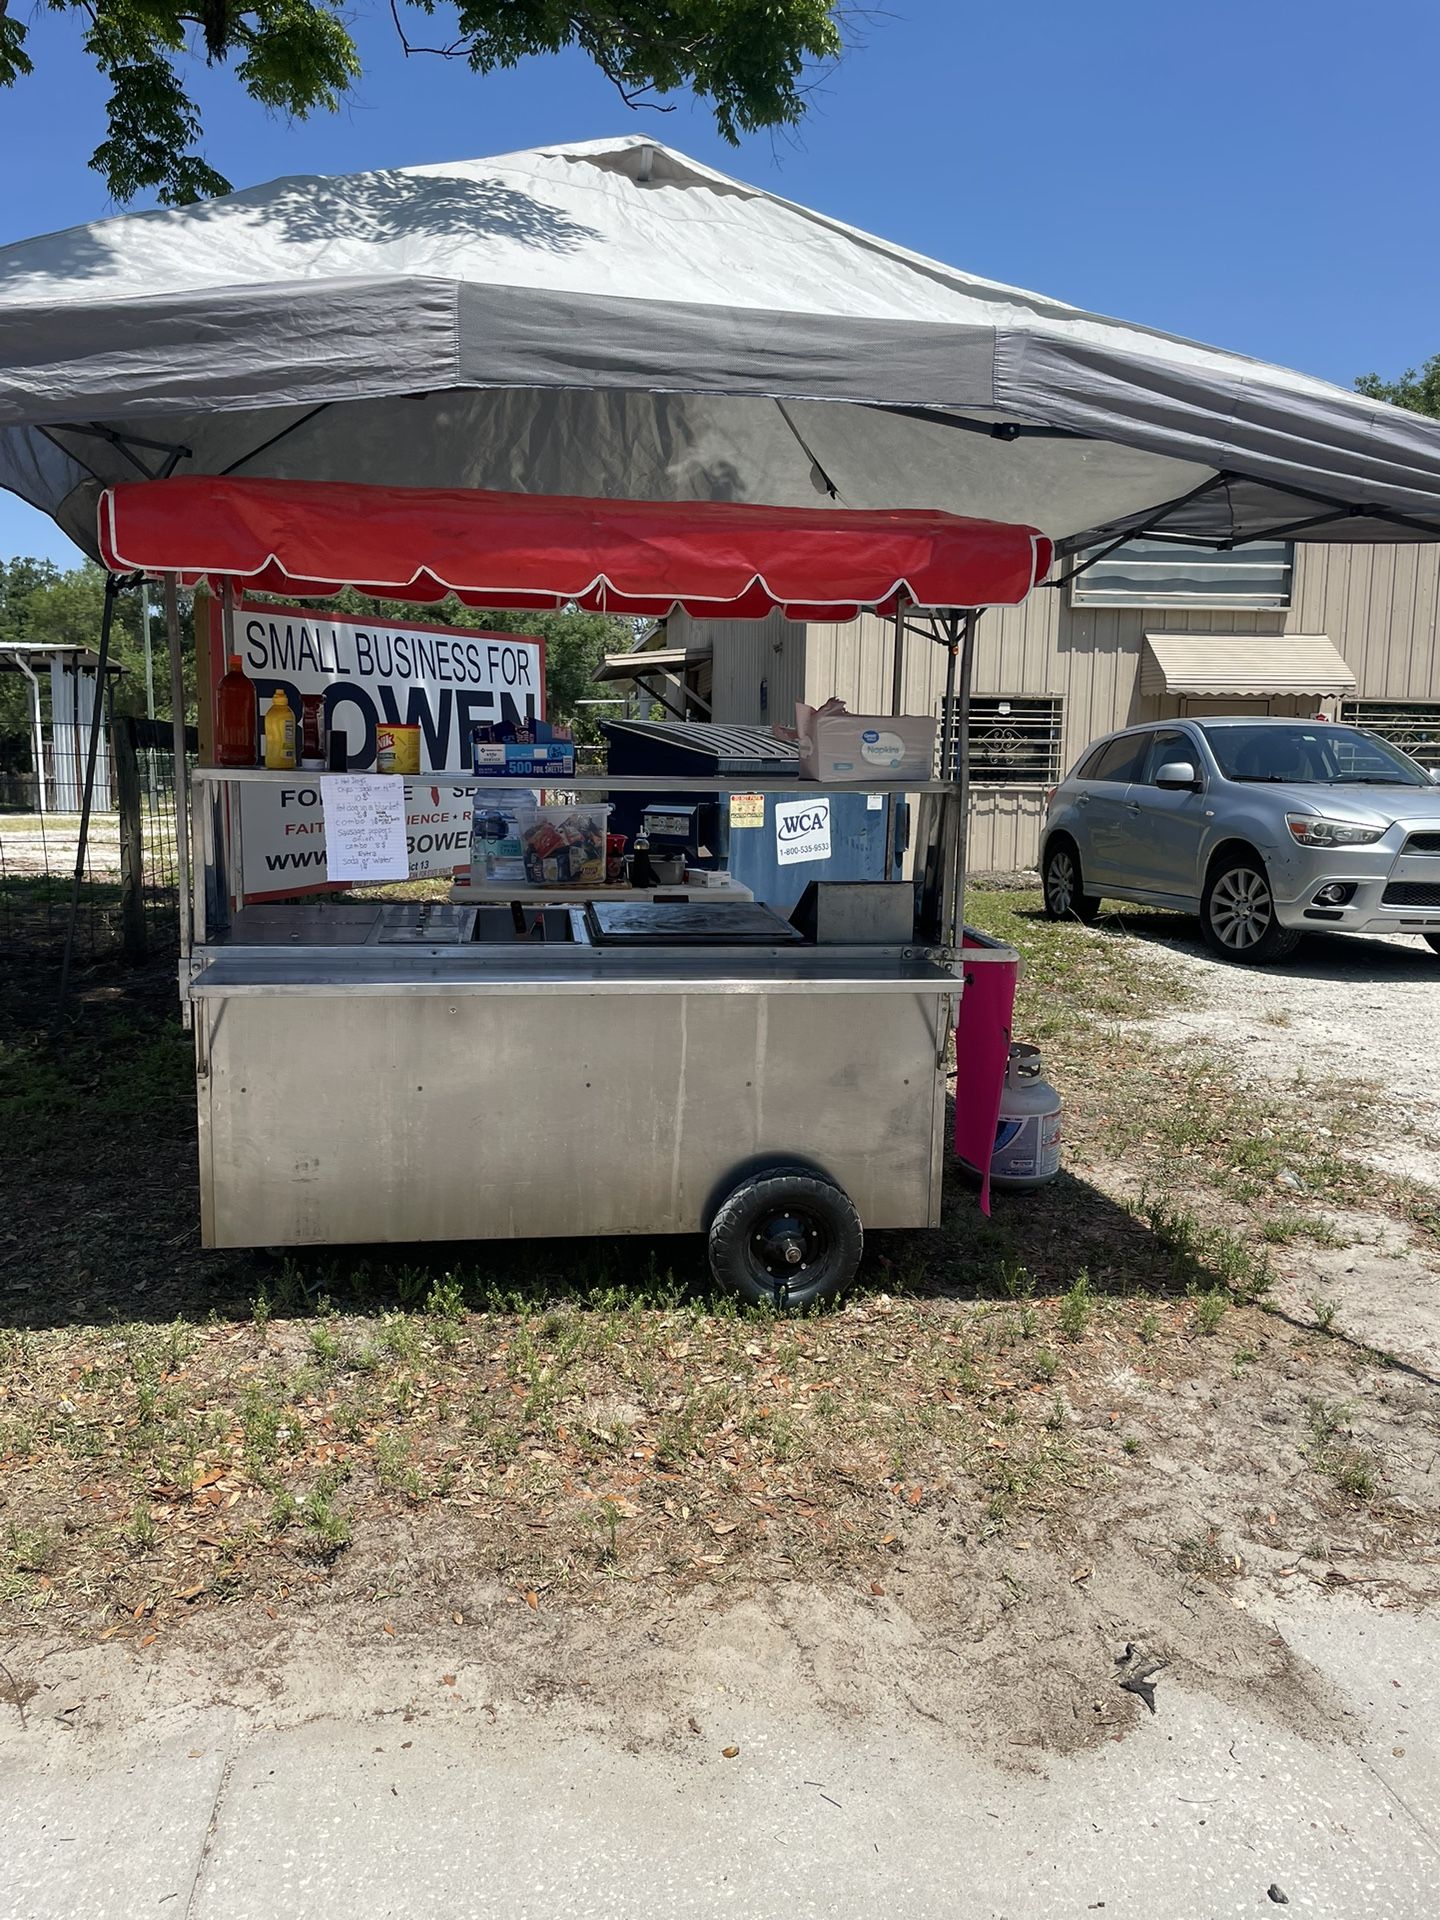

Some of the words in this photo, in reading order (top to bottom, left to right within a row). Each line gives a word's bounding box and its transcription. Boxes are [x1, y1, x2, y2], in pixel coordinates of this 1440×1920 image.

[246, 620, 350, 675] SMALL
[355, 632, 482, 684] BUSINESS
[487, 645, 531, 687] FOR
[867, 745, 900, 757] Napkins
[508, 761, 532, 774] 500
[533, 765, 544, 775] FOIL
[545, 765, 563, 775] SHEETS
[335, 817, 366, 826] combo
[406, 812, 450, 825] IENCE
[782, 812, 824, 833] WCA
[285, 822, 325, 836] FAIT
[779, 842, 830, 856] 1-800-535-9533
[420, 860, 429, 869] 13
